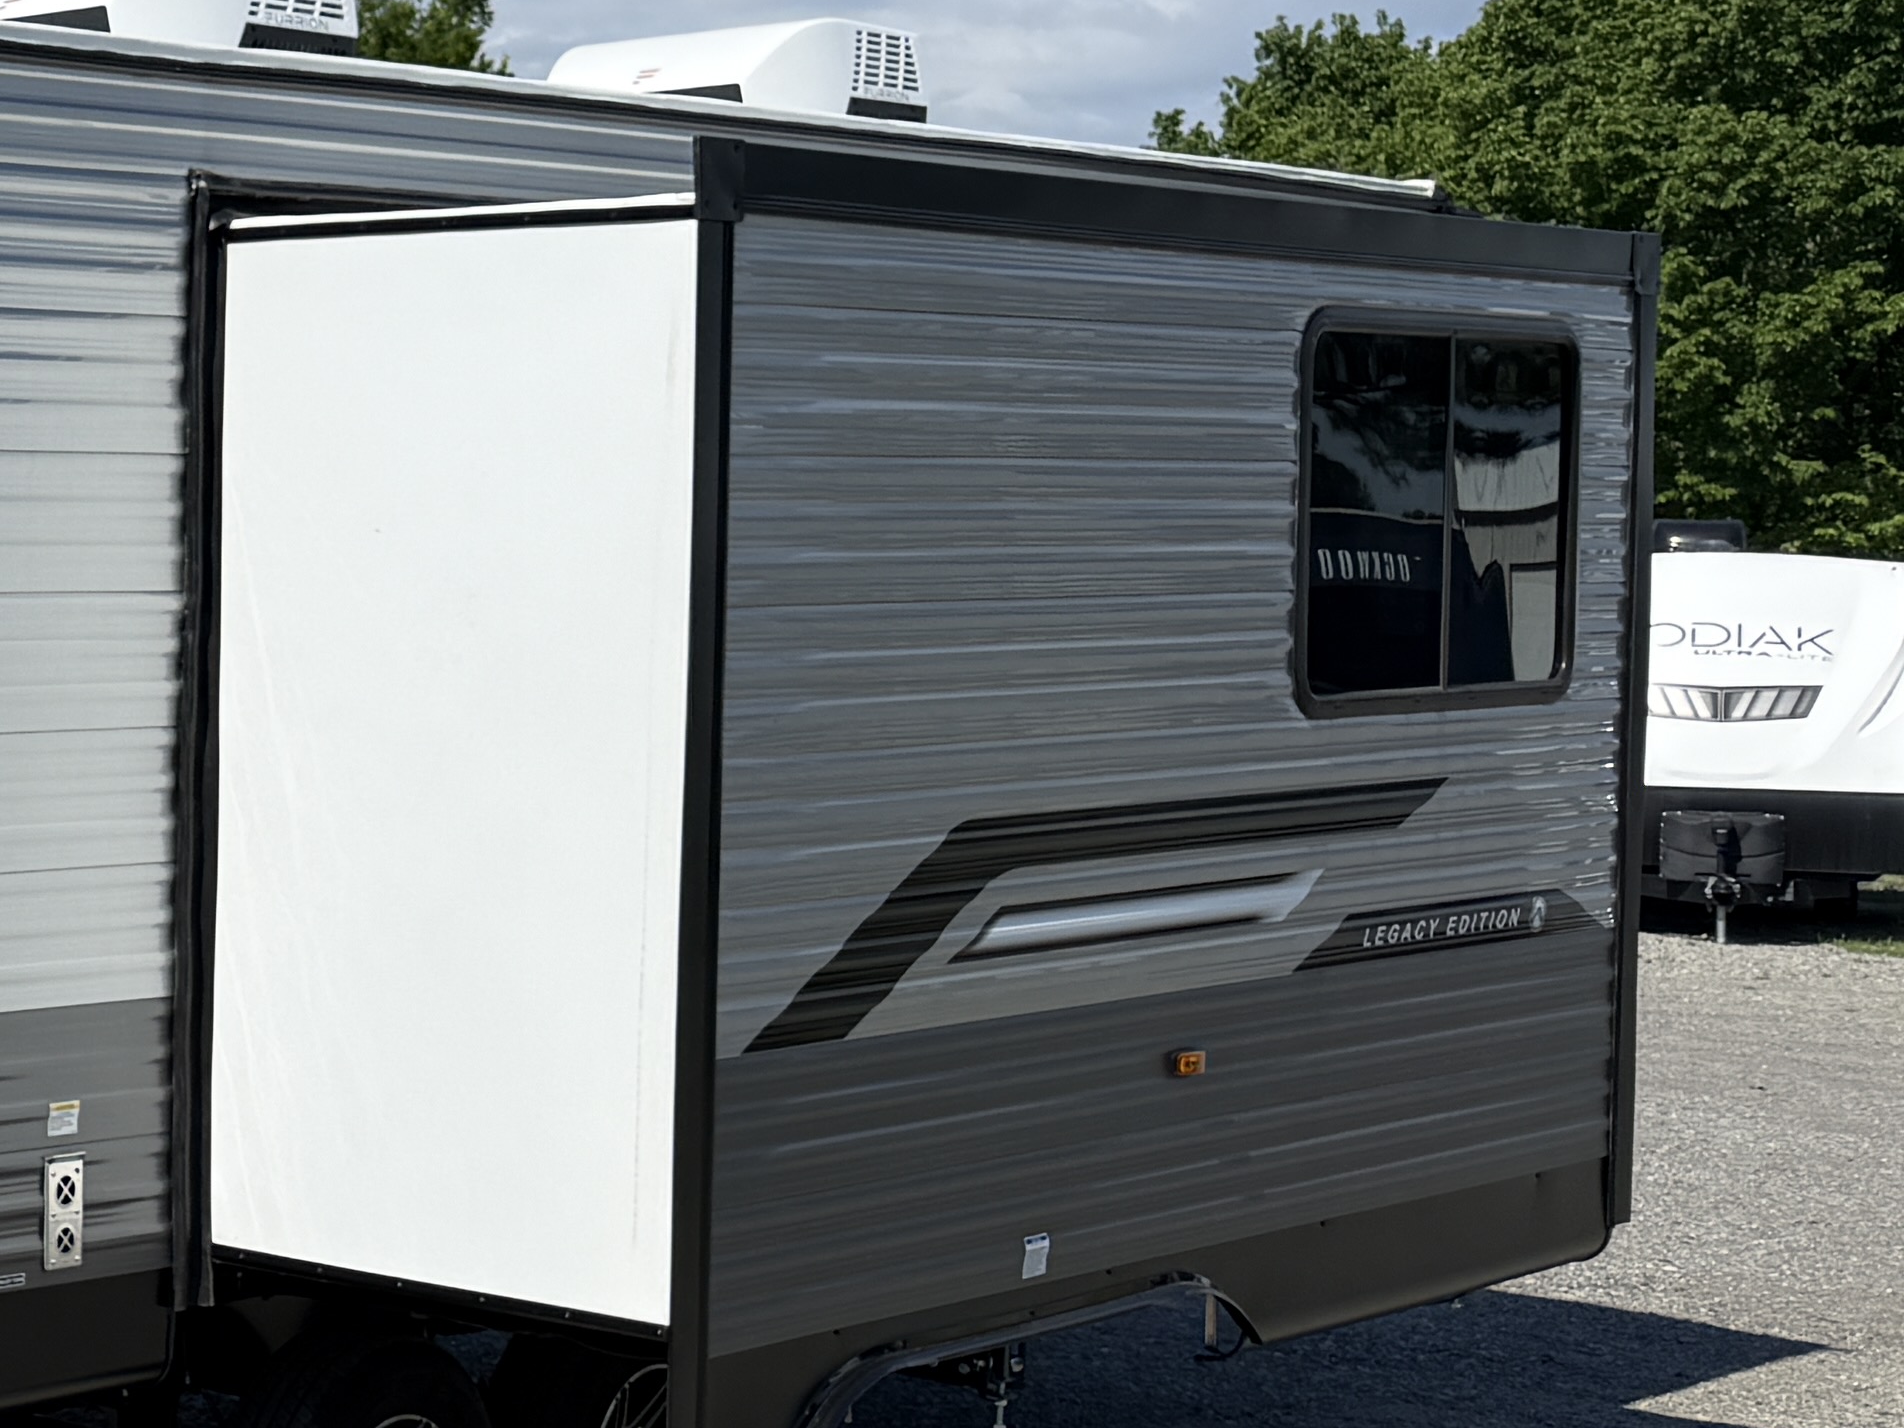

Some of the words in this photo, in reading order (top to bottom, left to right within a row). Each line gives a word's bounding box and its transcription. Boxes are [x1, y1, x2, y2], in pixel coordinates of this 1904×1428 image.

[1650, 622, 1834, 655] ODIAK
[1362, 918, 1440, 948] LEGACY
[1446, 907, 1521, 937] EDITION
